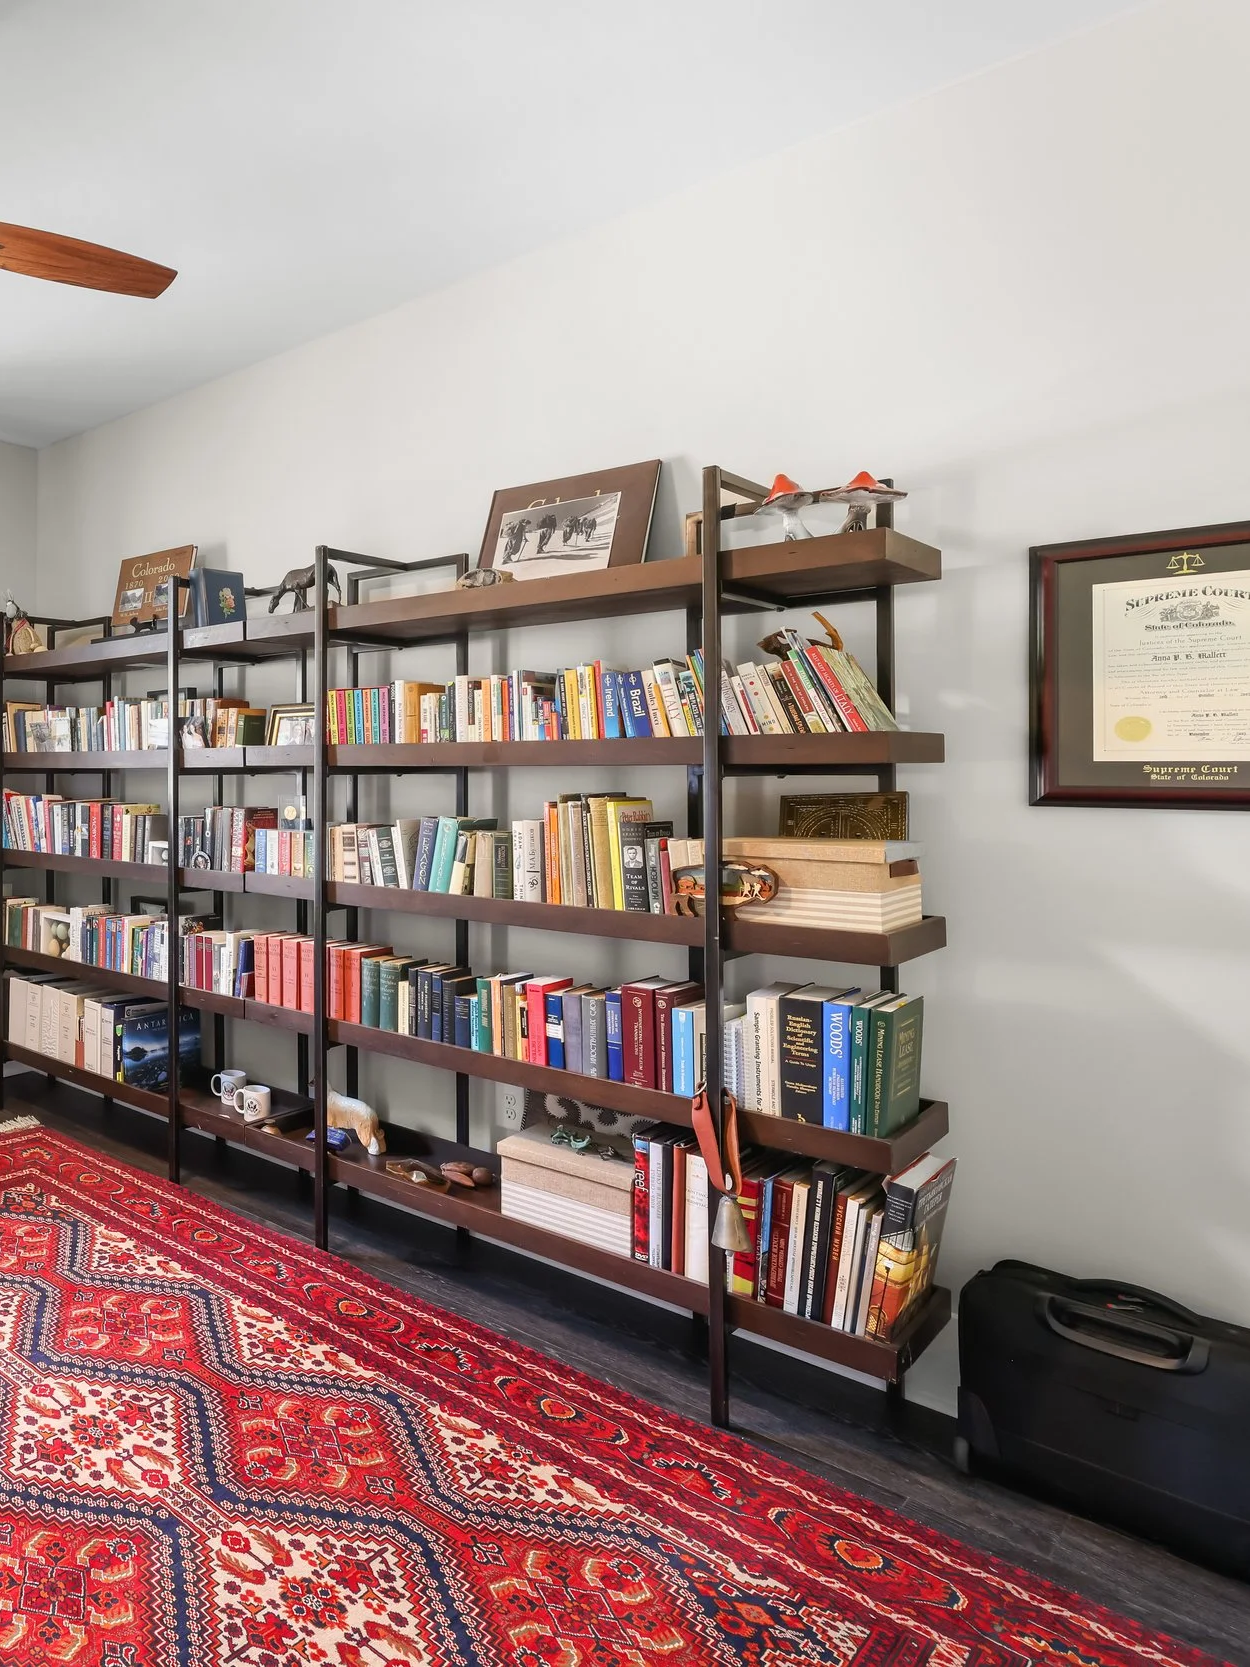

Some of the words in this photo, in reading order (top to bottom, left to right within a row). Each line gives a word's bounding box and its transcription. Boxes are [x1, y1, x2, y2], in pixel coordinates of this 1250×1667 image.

[132, 558, 175, 578] Colorado
[125, 580, 143, 589] 1870
[1125, 589, 1198, 611] SUPREME
[605, 688, 614, 717] Ireland
[630, 689, 645, 717] Brazil
[646, 682, 656, 706] Stanley
[662, 687, 681, 721] ITALY
[835, 693, 854, 714] ITALY
[813, 695, 824, 712] Survival
[821, 713, 830, 725] Guide
[1142, 764, 1196, 774] Supreme
[1201, 765, 1238, 773] Court
[418, 837, 430, 885] ERAGON
[136, 1013, 194, 1031] ANTARICA
[786, 1015, 812, 1023] Russian-
[789, 1021, 811, 1029] English
[786, 1026, 817, 1036] Dictionary
[786, 1035, 814, 1043] Scientific
[877, 1028, 885, 1049] MINING
[783, 1043, 818, 1054] Engineering
[899, 1042, 913, 1058] LEASE
[876, 1050, 884, 1068] LEASE
[874, 1068, 883, 1100] HANDBOOK
[755, 1097, 763, 1106] for
[635, 1168, 648, 1192] reef
[834, 1205, 844, 1235] РУССКИЙ
[811, 1222, 820, 1241] ИСКУССТВ
[832, 1238, 840, 1260] МУЗЕЙ
[808, 1242, 818, 1280] ИЗОБРАЗИТЕЛЬНЫХ
[806, 1281, 815, 1294] МУЗЕЙ
